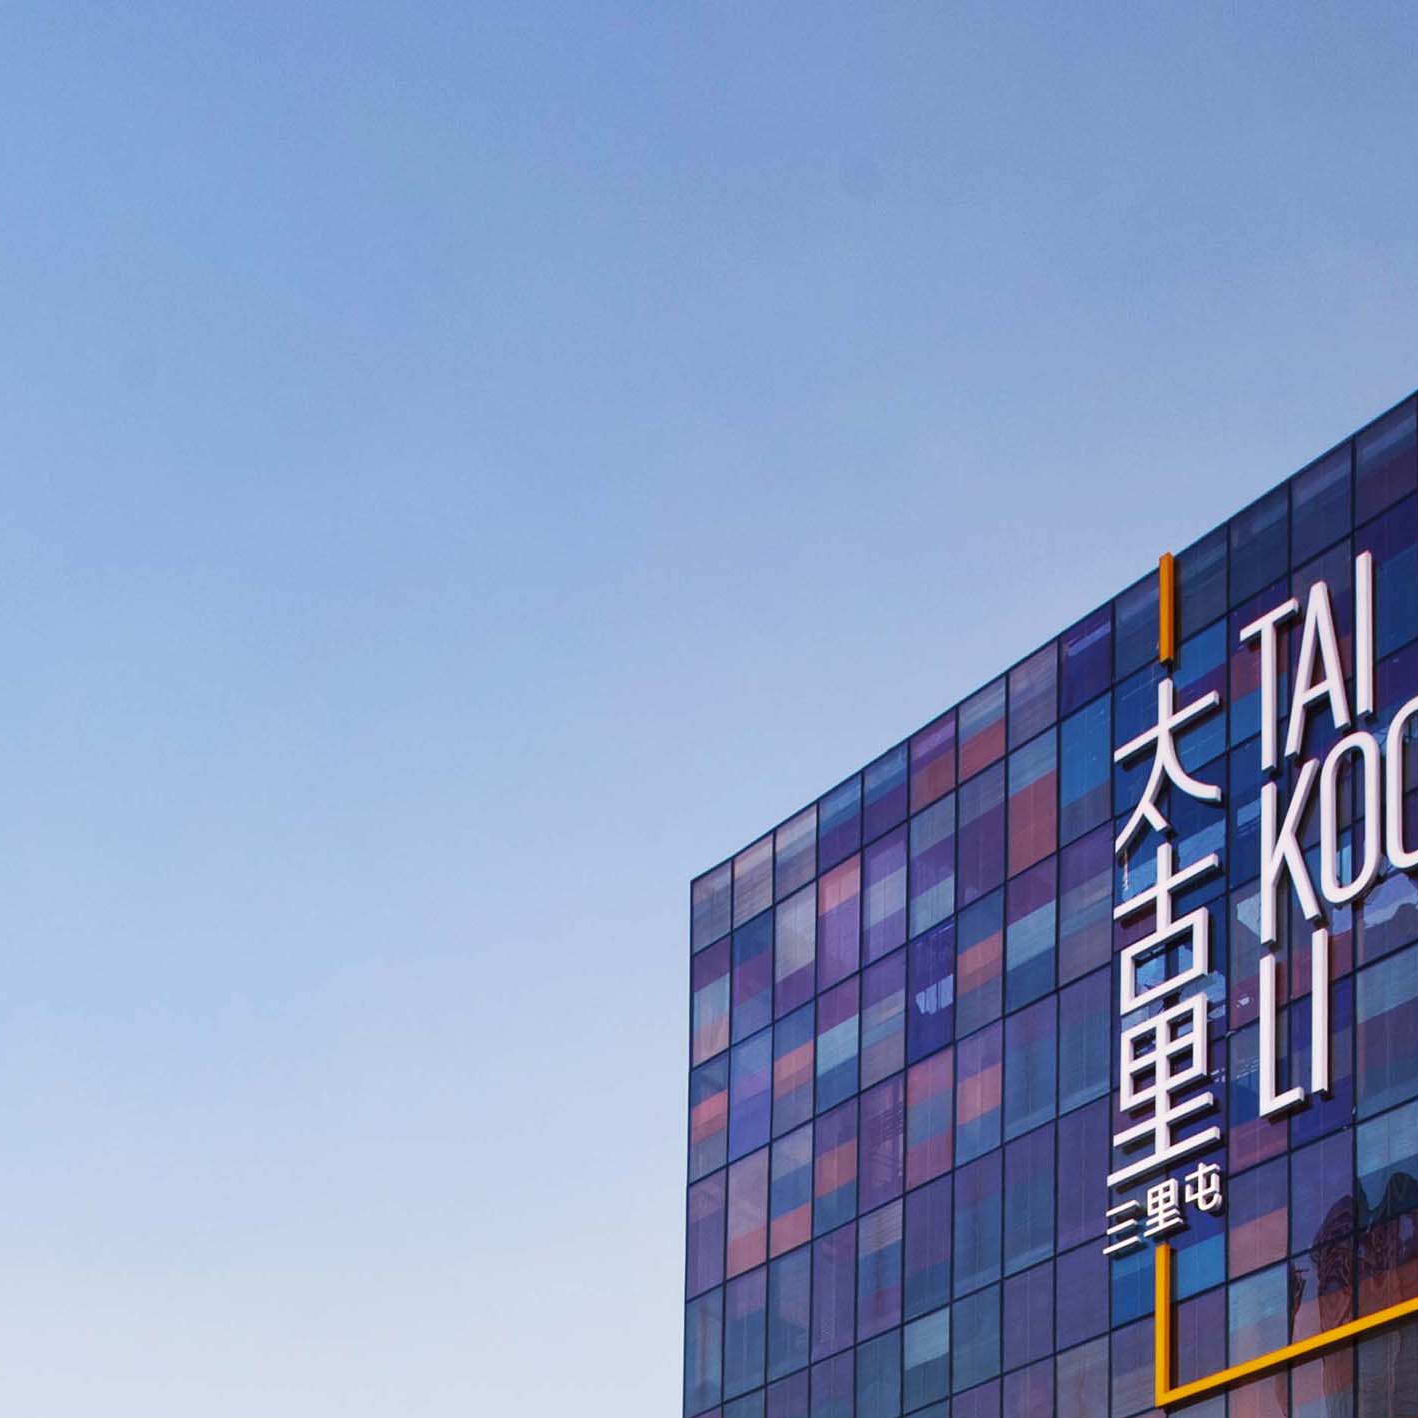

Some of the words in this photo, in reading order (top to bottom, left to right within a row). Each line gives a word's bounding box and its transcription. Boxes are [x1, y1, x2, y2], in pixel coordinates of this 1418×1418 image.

[1240, 550, 1376, 772] TAI
[1107, 678, 1222, 1186] 太古里
[1260, 928, 1330, 1119] LI
[1103, 1162, 1223, 1255] 三里屯
